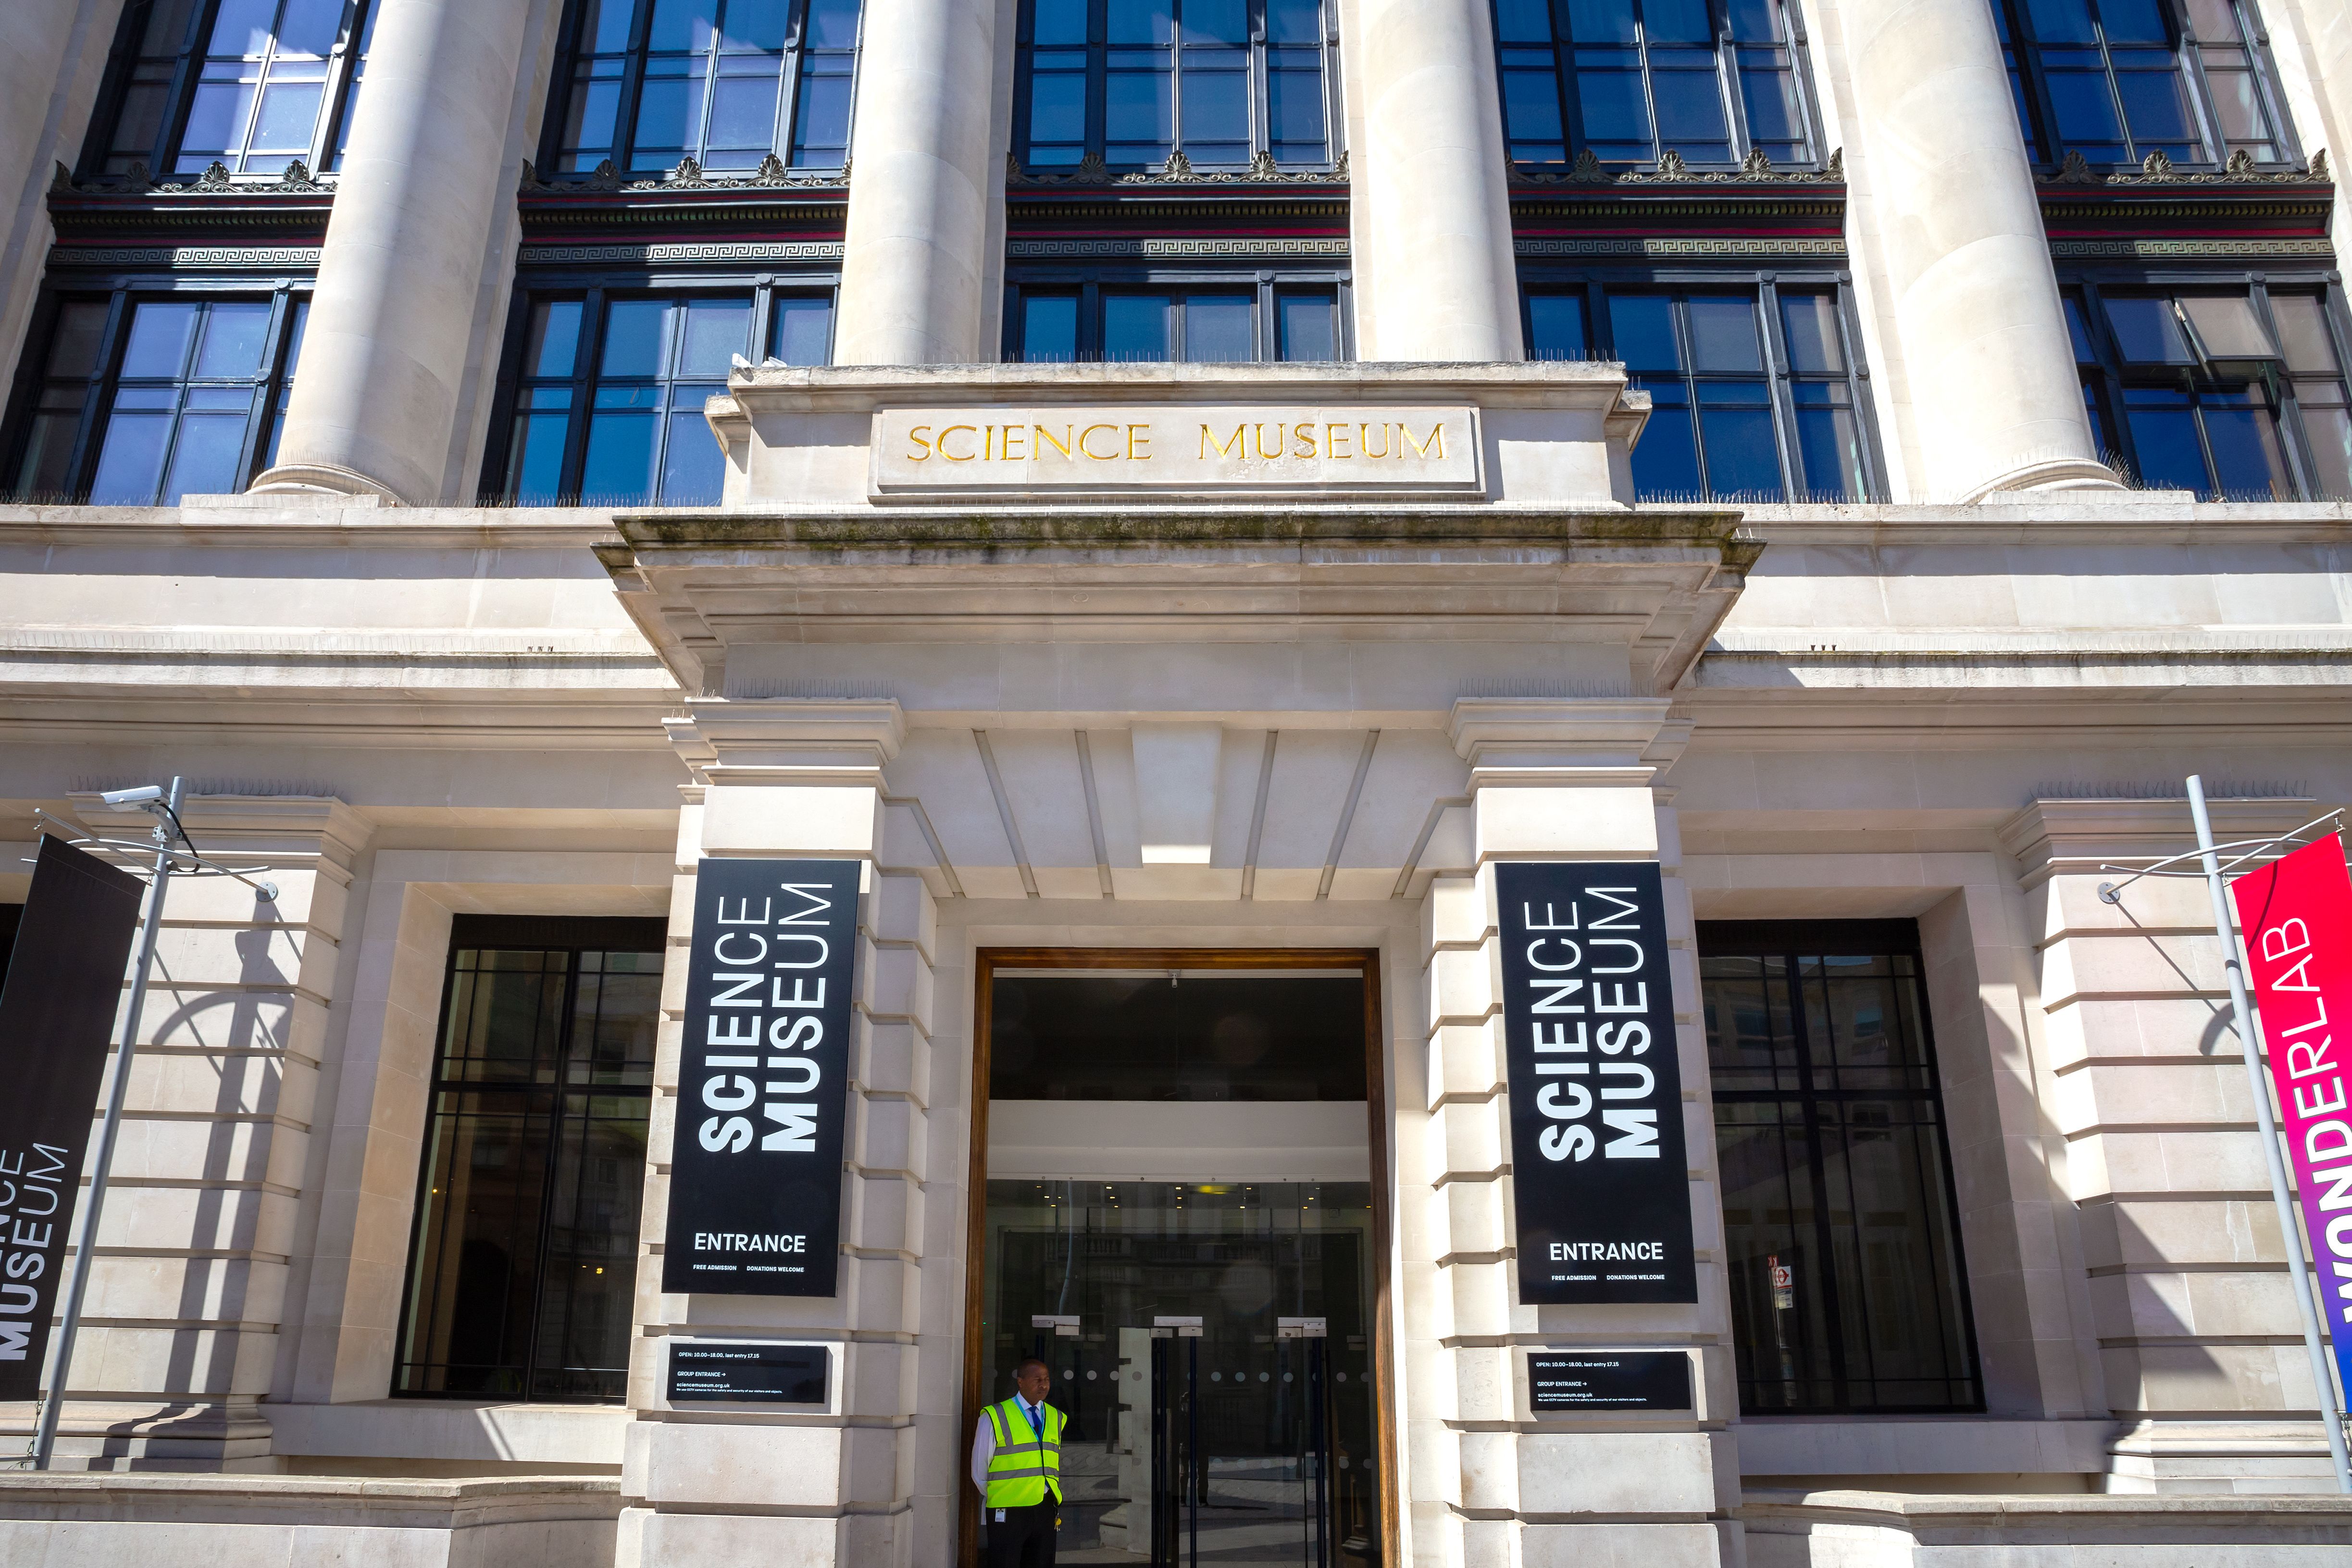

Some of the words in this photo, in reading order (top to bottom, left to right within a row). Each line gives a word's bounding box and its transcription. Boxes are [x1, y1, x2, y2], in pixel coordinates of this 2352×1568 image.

[907, 424, 1153, 461] SCIENCE
[1198, 423, 1448, 460] MUSEUM
[698, 896, 771, 1154] SCIENCE
[761, 884, 833, 1152] MUSEUM
[1524, 902, 1595, 1162] SCIENCE
[1584, 887, 1660, 1158] MUSEUM
[0, 1143, 68, 1360] MUSEUM
[694, 1232, 806, 1253] ENTRANCE
[1550, 1242, 1664, 1261] ENTRANCE
